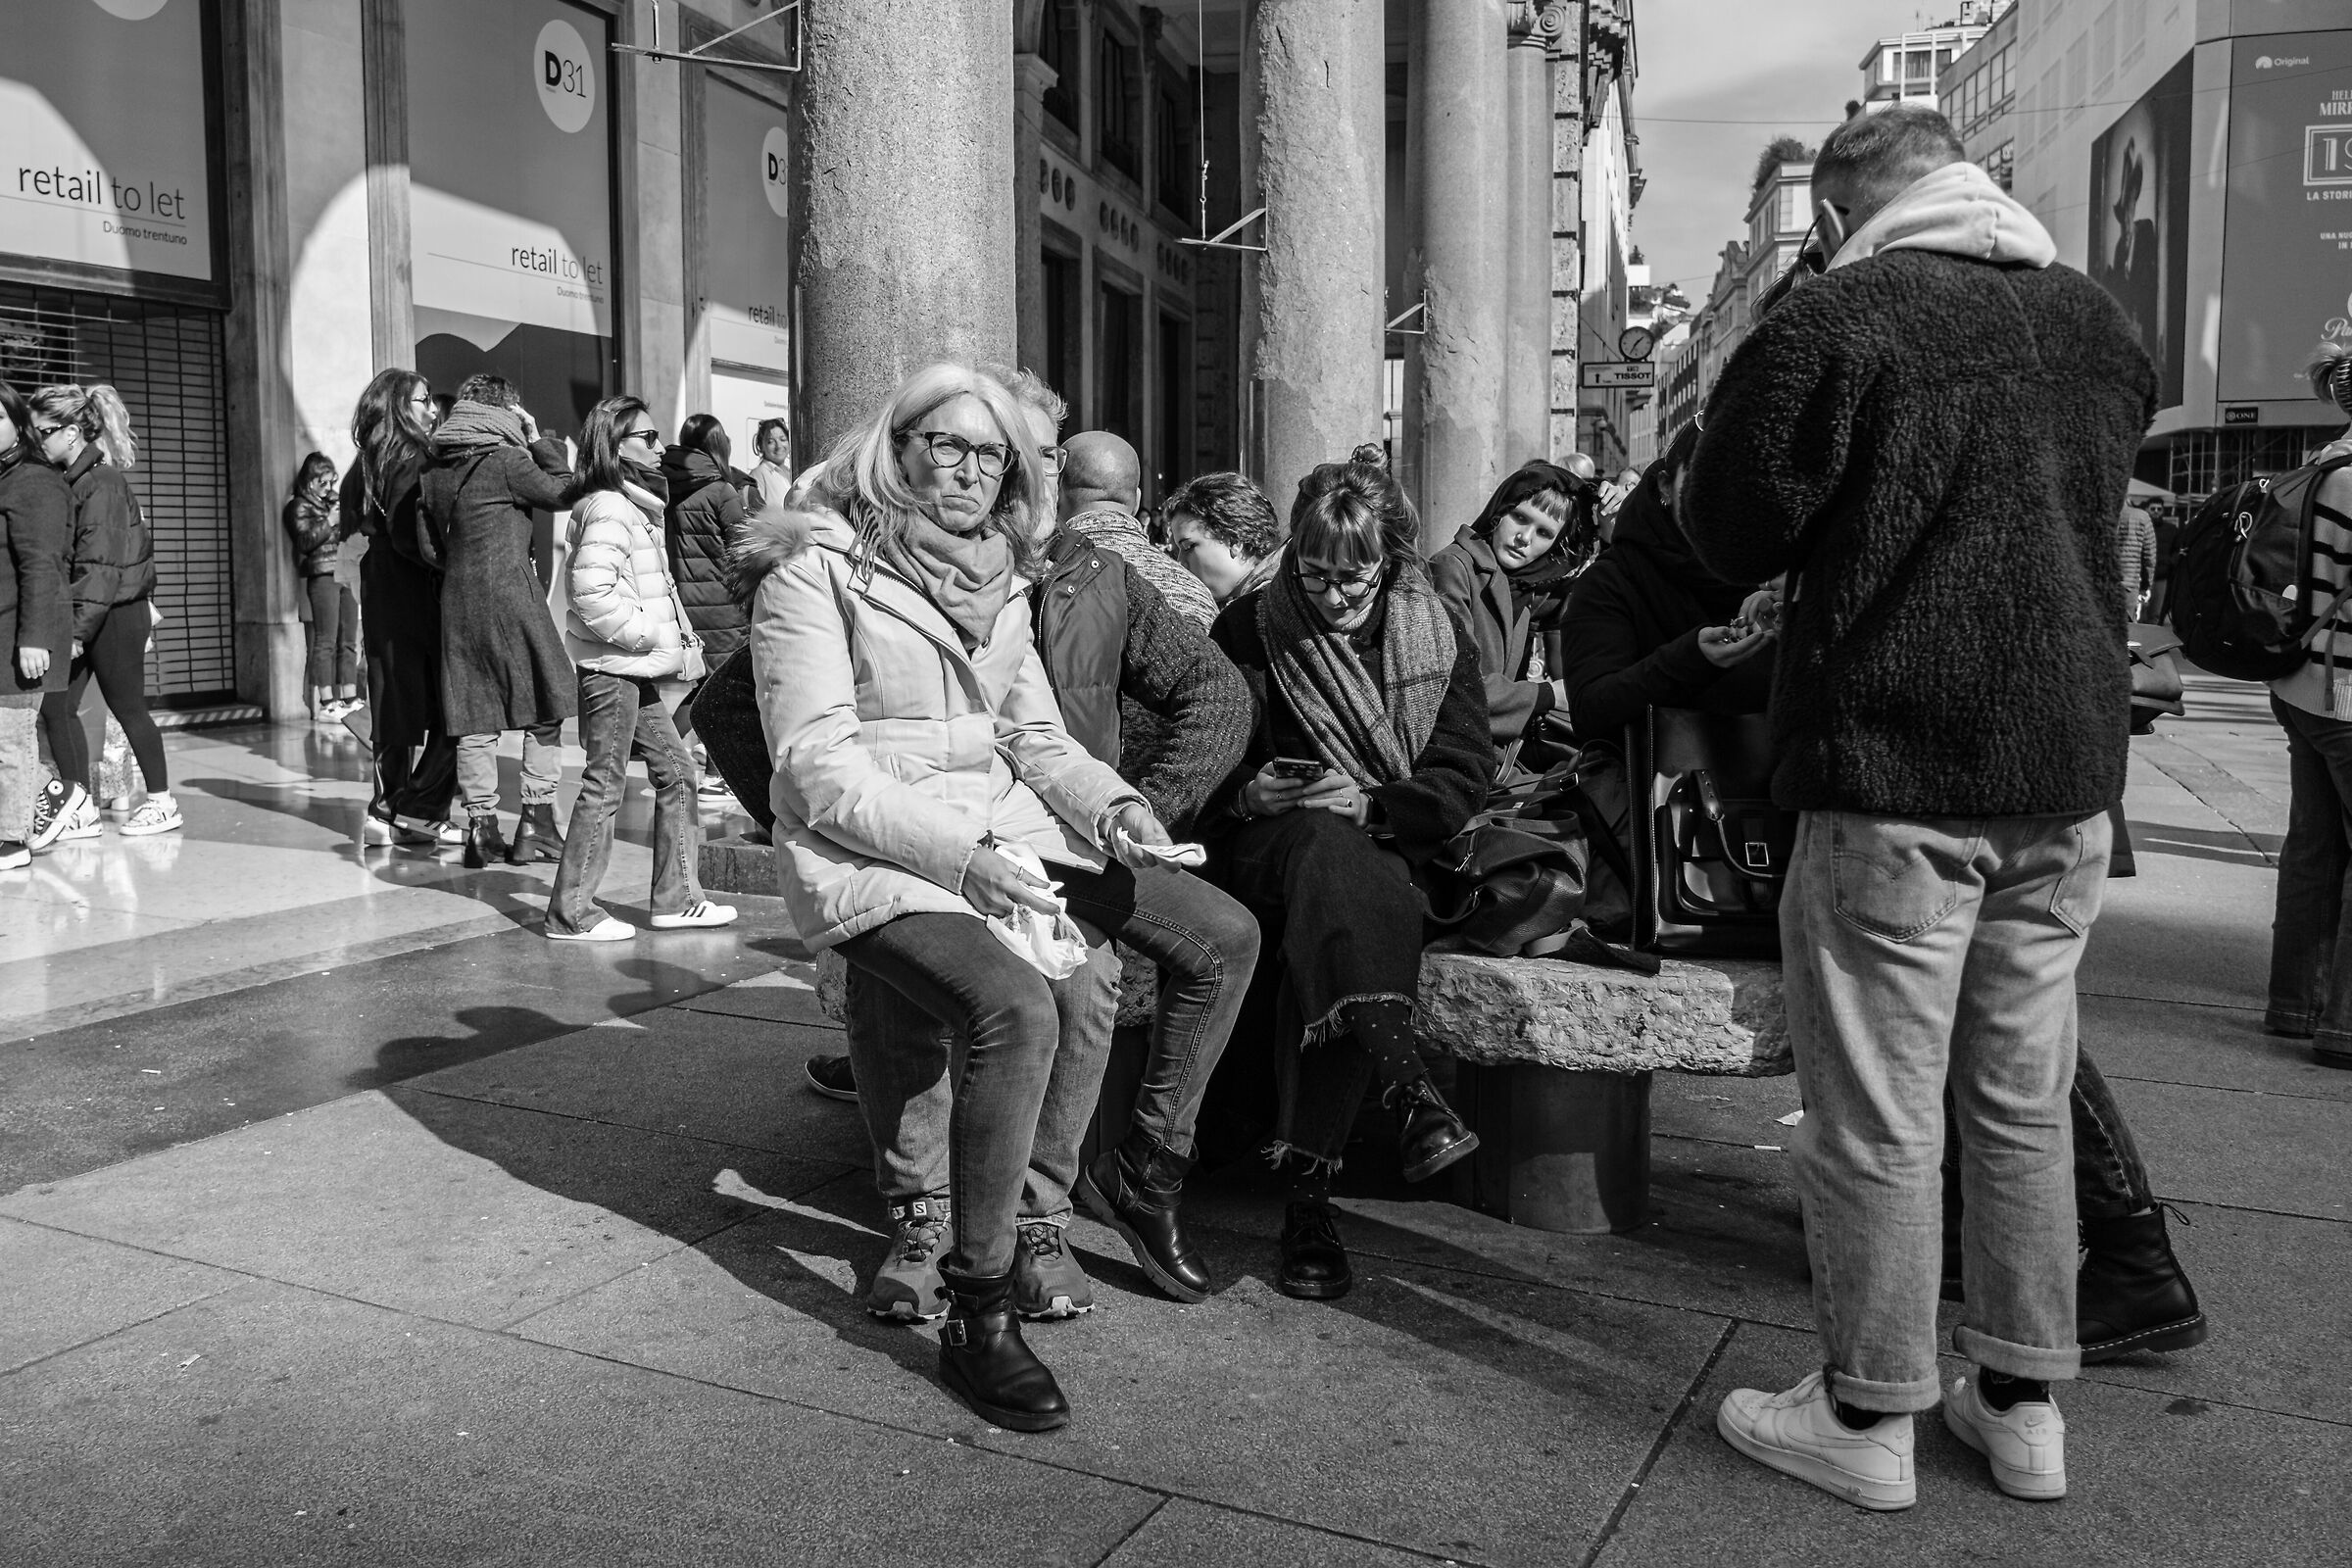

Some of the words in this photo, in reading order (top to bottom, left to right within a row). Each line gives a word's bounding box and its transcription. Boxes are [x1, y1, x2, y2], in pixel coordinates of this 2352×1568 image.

[2274, 56, 2310, 68] Original
[544, 49, 587, 98] D31
[2331, 89, 2352, 101] HEL
[19, 166, 102, 205] retail
[111, 176, 142, 212] to
[150, 180, 186, 220] let
[2306, 191, 2320, 201] LA
[103, 220, 142, 238] Duomo
[143, 228, 188, 245] trentuno
[2320, 231, 2336, 240] UNA
[512, 246, 558, 274] retail
[562, 253, 579, 279] to
[582, 256, 603, 285] let
[748, 305, 775, 327] retail
[1614, 371, 1651, 380] TISSOT
